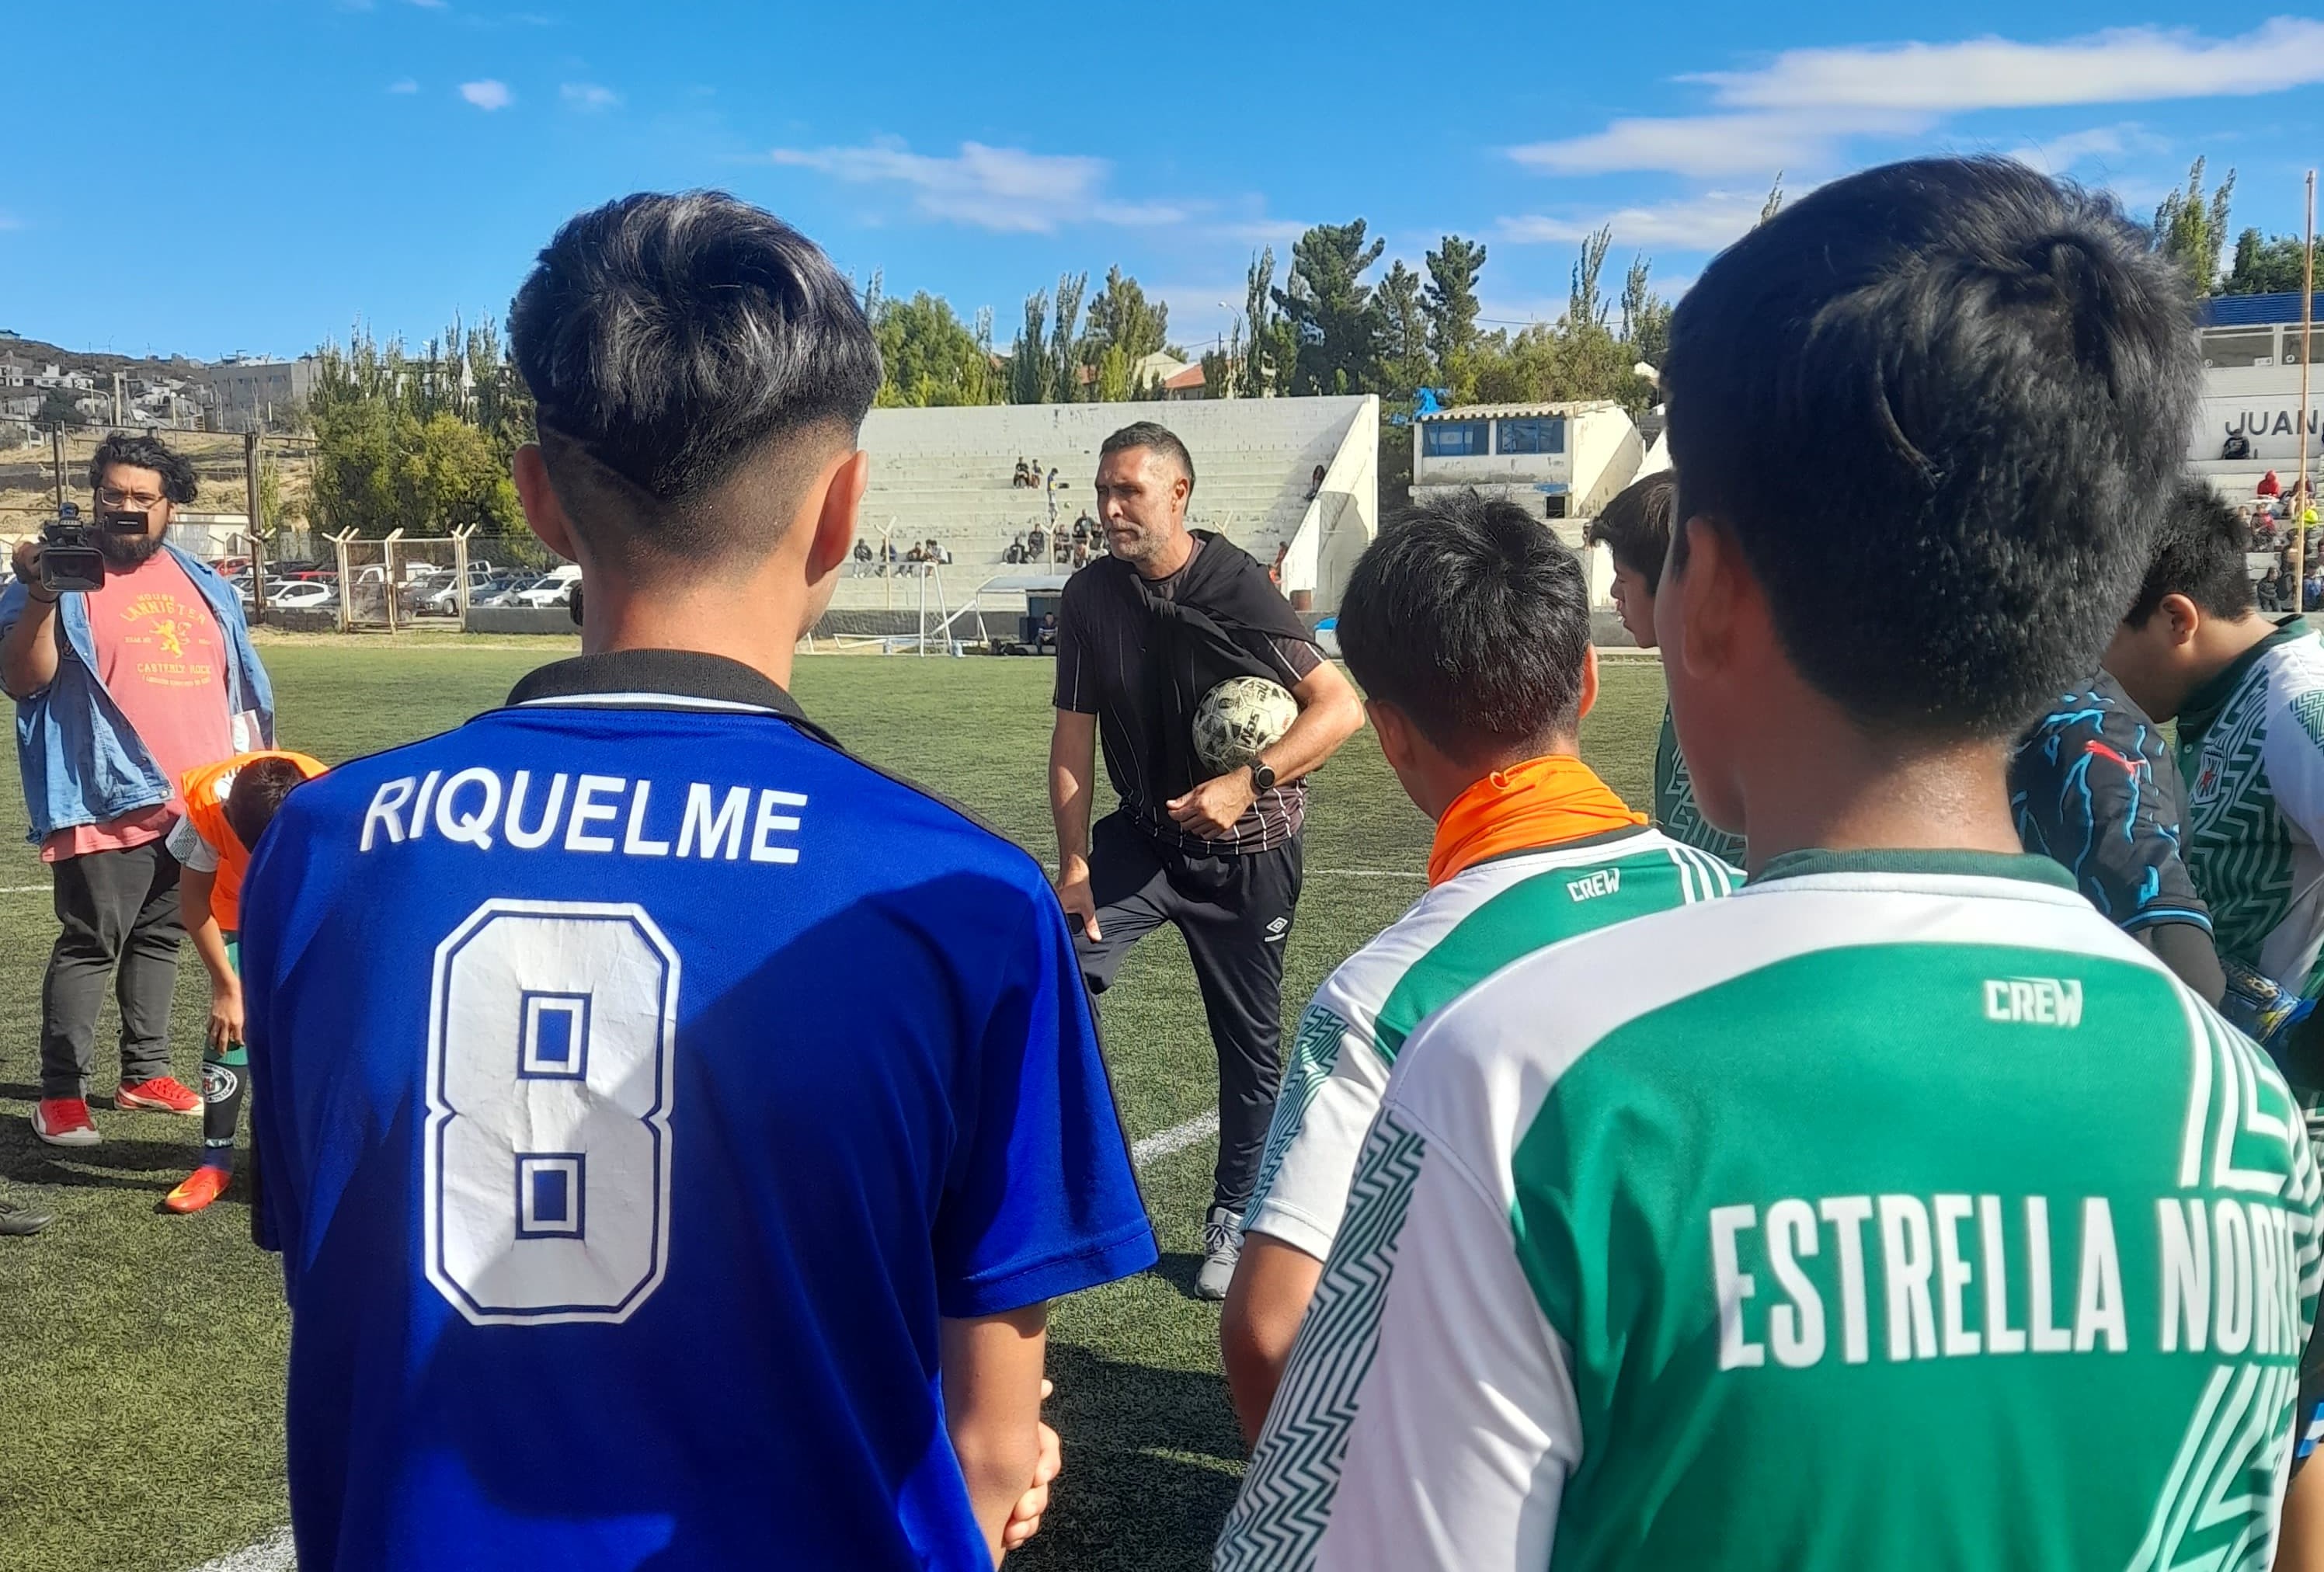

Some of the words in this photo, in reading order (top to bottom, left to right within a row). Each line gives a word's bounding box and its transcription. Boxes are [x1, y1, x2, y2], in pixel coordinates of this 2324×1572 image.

[359, 767, 809, 864] RIQUELME
[1566, 867, 1620, 902] CREW
[1985, 976, 2083, 1028] CREW
[423, 897, 683, 1327] 8
[1709, 1193, 2128, 1372] ESTRELLA
